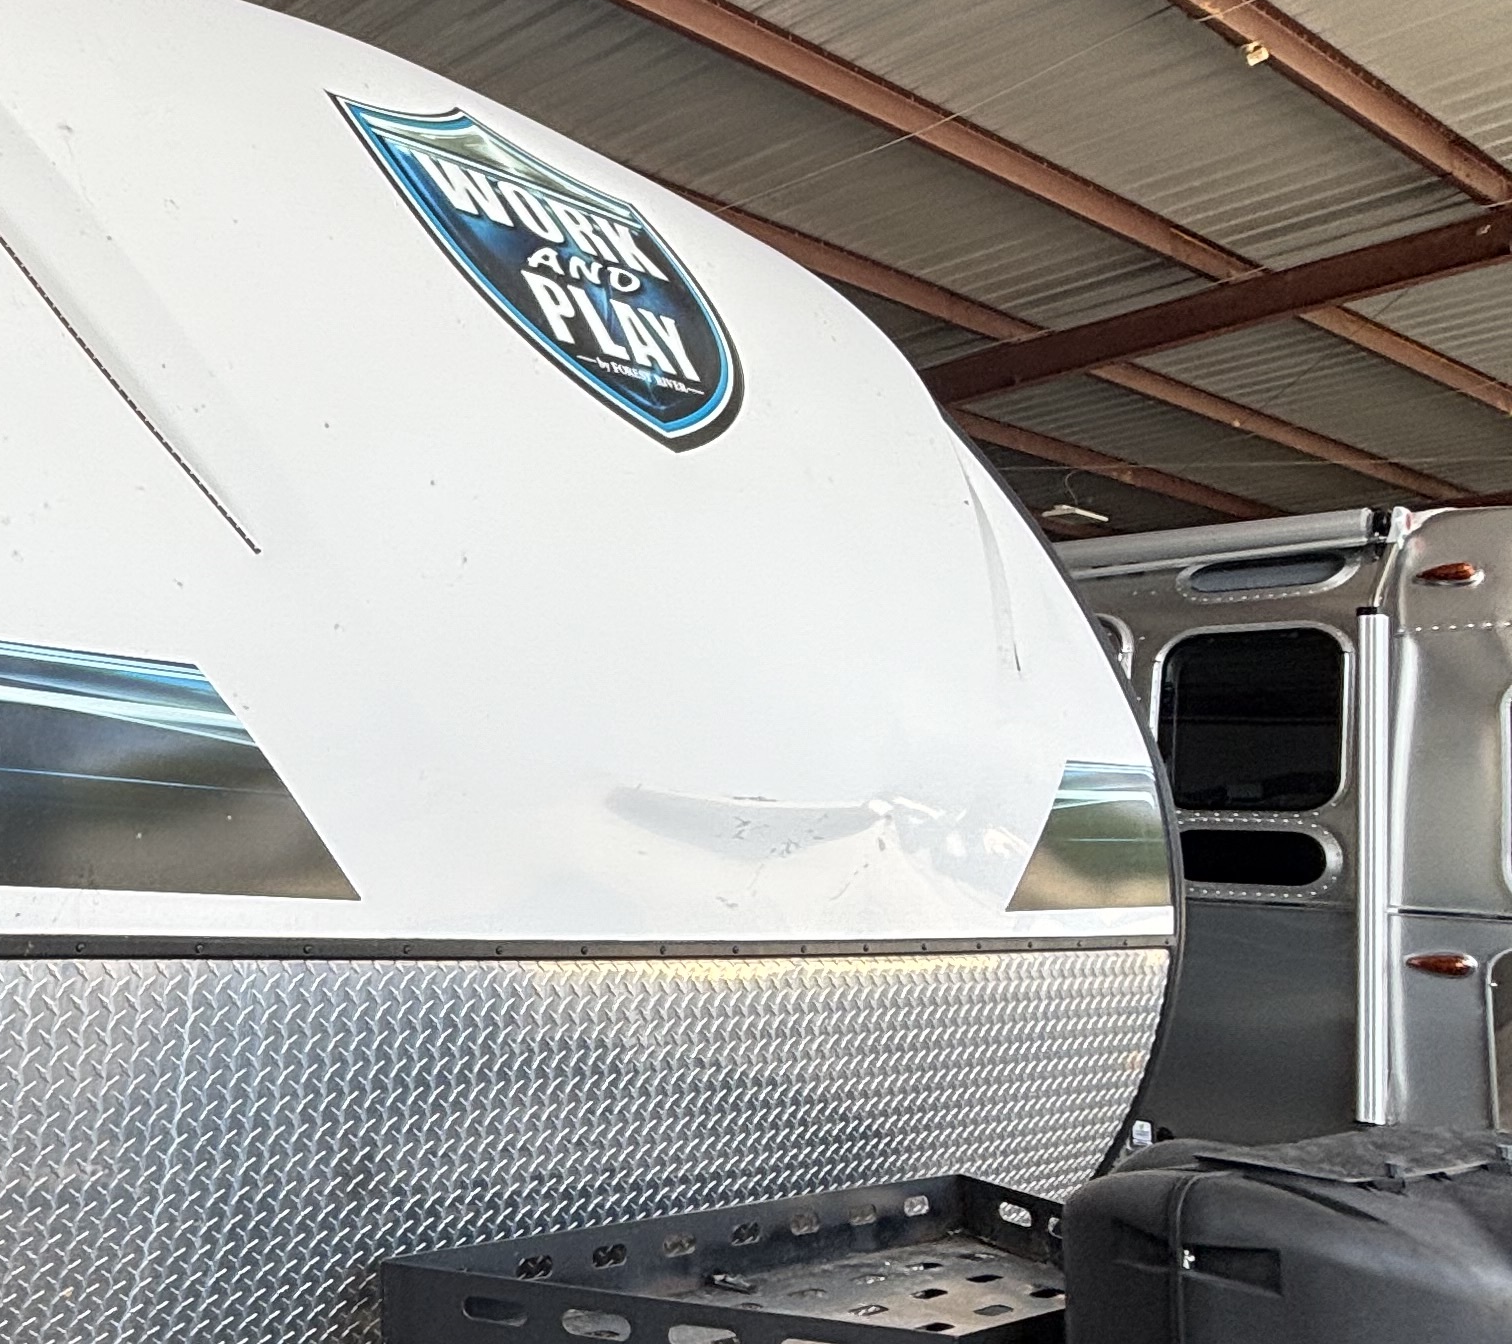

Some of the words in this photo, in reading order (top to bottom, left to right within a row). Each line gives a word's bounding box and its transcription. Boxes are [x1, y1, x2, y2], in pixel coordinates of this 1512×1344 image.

[410, 149, 670, 282] WORK
[526, 247, 641, 292] AND
[521, 270, 701, 382] PLAY
